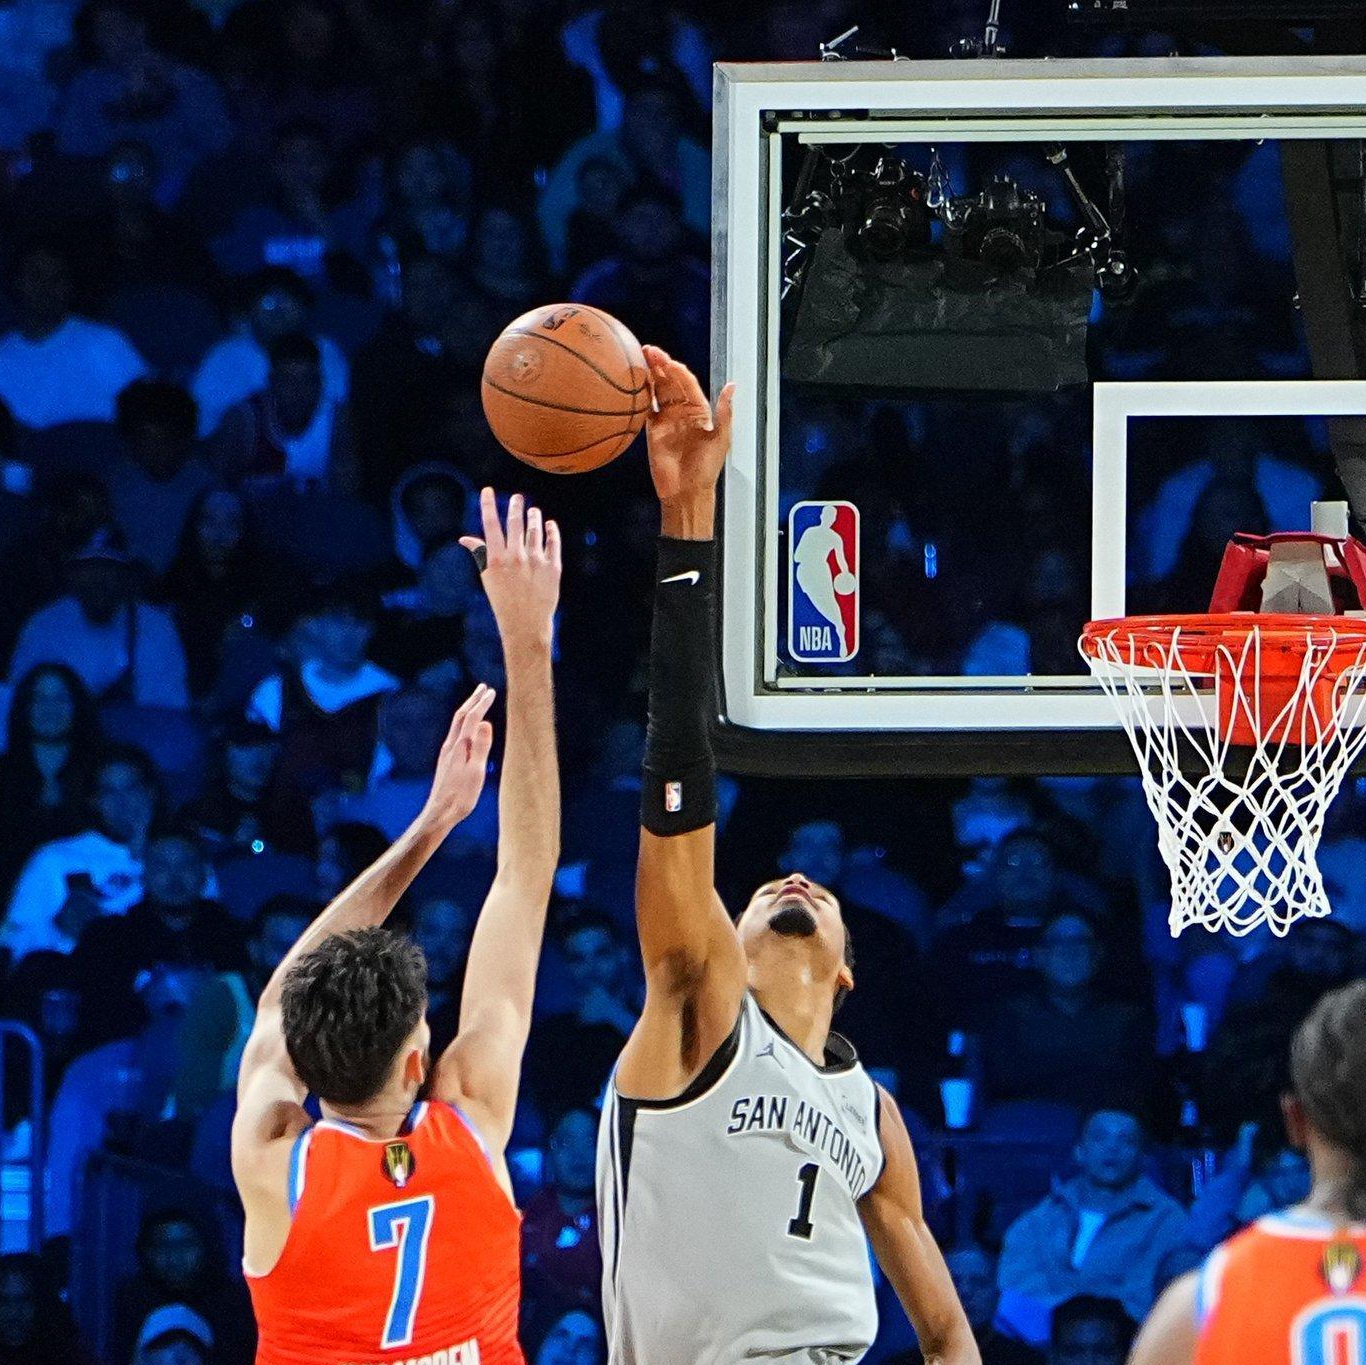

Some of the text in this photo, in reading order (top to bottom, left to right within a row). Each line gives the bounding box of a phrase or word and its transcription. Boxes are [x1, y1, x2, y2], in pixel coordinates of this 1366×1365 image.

[799, 626, 833, 651] NBA
[726, 1096, 789, 1136] SAN
[787, 1163, 820, 1241] 1
[367, 1194, 435, 1350] 7
